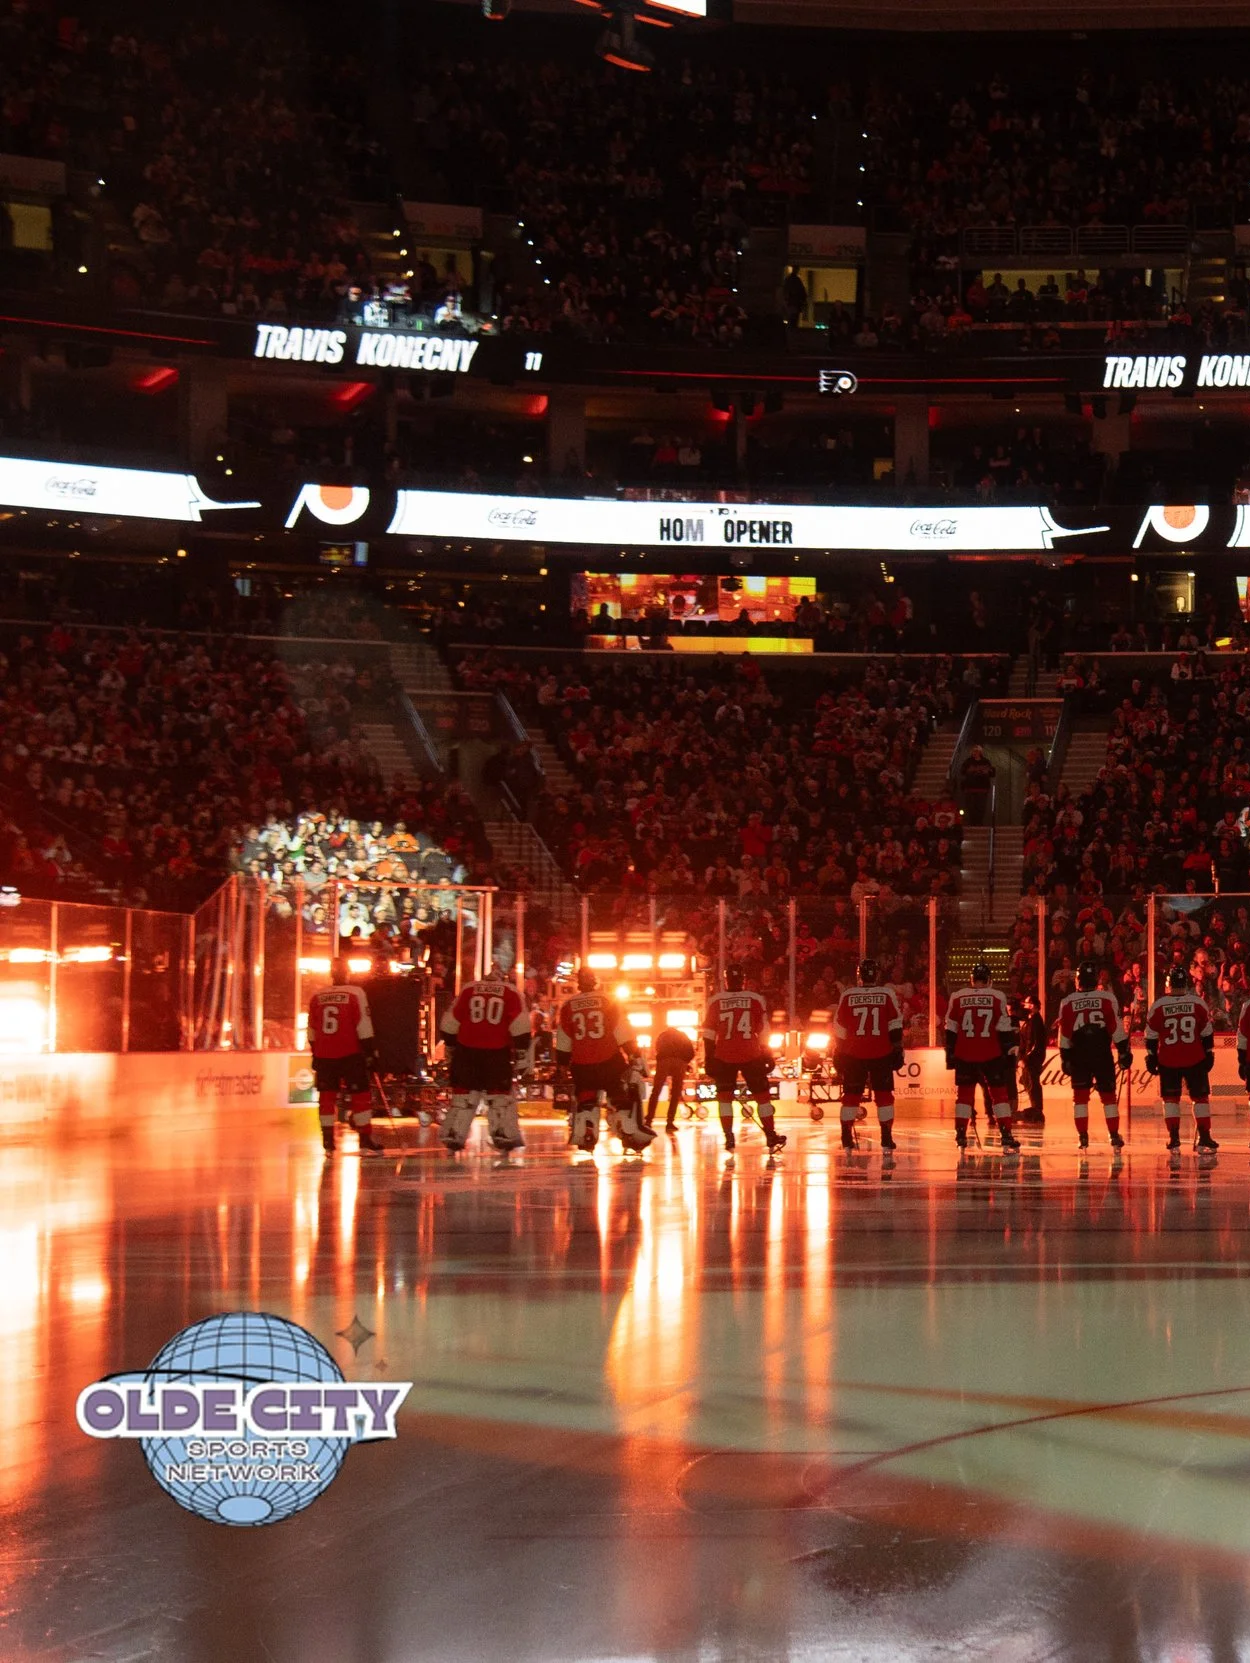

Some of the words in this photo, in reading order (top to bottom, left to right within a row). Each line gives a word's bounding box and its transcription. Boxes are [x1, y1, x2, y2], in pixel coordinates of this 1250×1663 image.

[254, 324, 347, 363] TRAVIS
[356, 332, 479, 373] KONECNY
[525, 352, 543, 371] 11
[1103, 356, 1186, 388] TRAVIS
[723, 519, 792, 544] OPENER
[983, 708, 1008, 718] Hard
[1009, 708, 1032, 720] Rock
[984, 725, 1002, 736] 120
[469, 996, 503, 1025] 80
[849, 994, 885, 1004] FOERSTER
[1073, 1000, 1100, 1010] ZEGRAS
[1164, 1004, 1193, 1015] MICHKOV
[322, 1006, 339, 1034] 6
[572, 1011, 605, 1041] 33
[719, 1010, 752, 1040] 74
[852, 1006, 881, 1036] 71
[961, 1009, 993, 1038] 47
[1072, 1010, 1107, 1030] 46
[1163, 1015, 1196, 1045] 39
